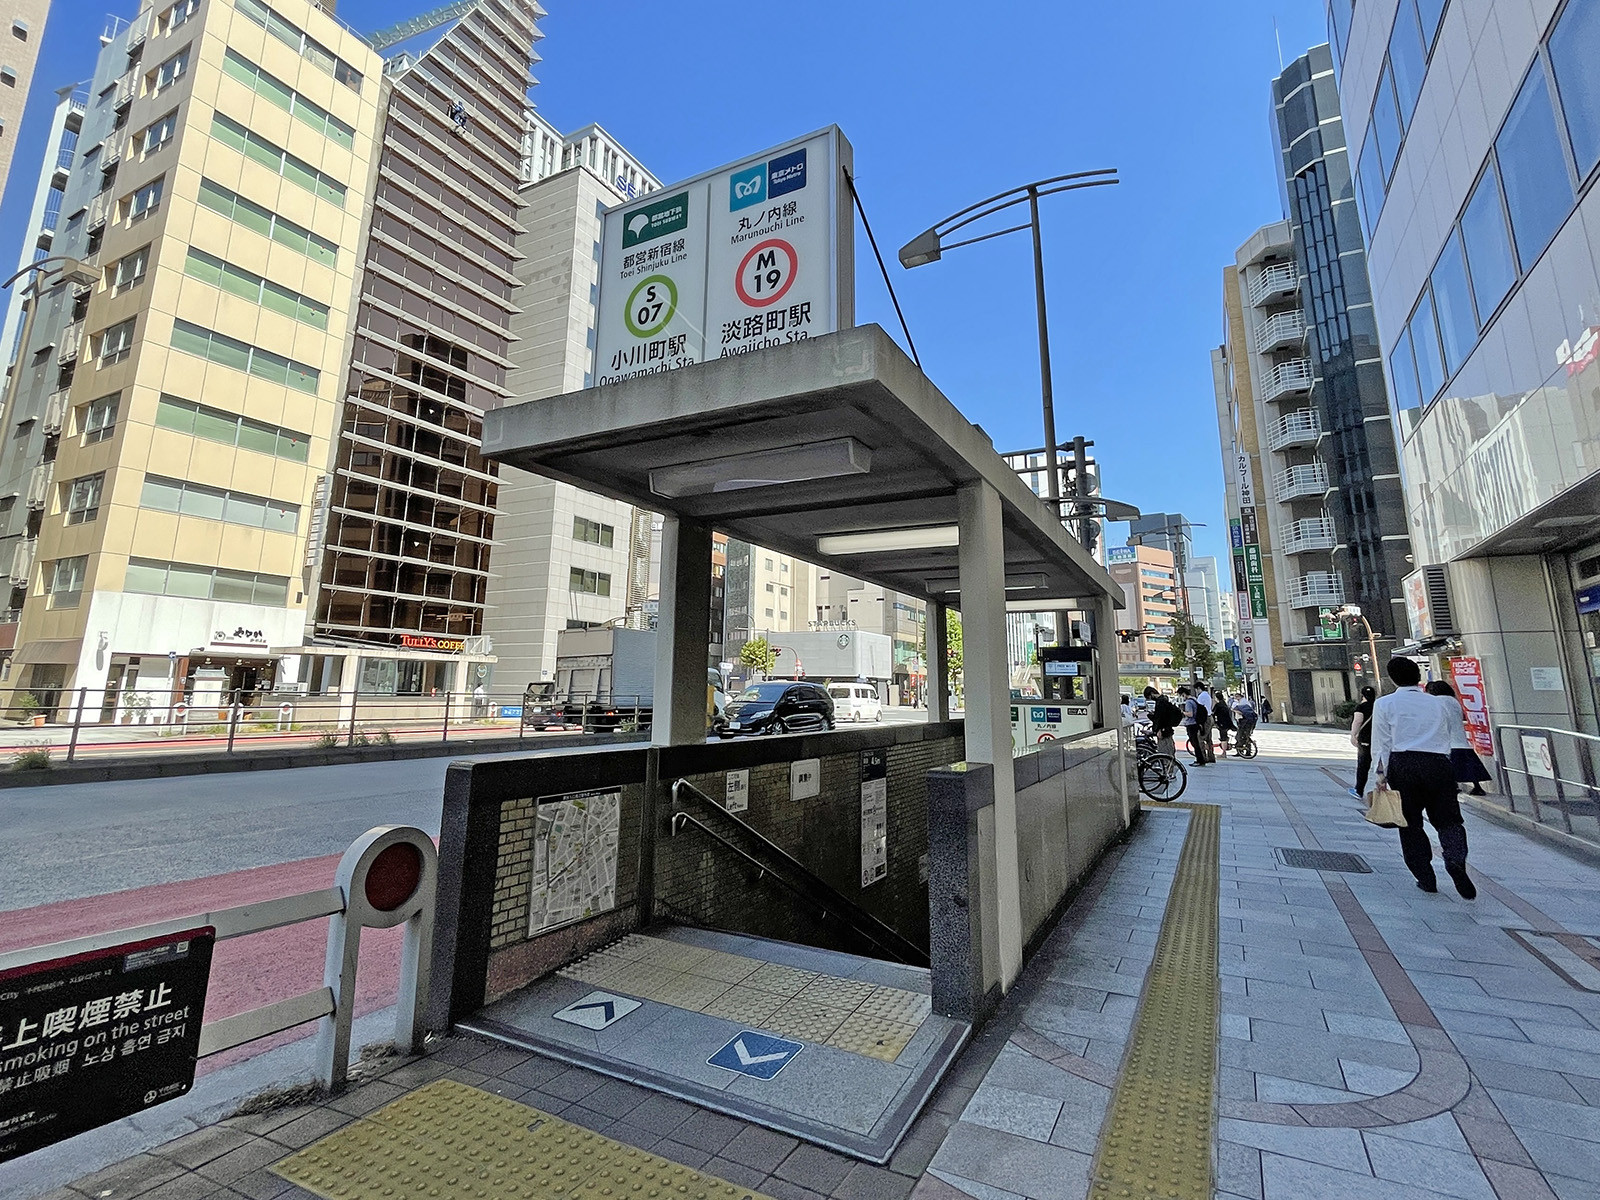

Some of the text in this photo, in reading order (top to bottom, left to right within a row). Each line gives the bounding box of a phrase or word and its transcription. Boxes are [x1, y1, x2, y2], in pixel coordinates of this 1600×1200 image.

[771, 163, 804, 179] 東京メトロ
[730, 215, 805, 245] Marunouchi Line
[738, 201, 797, 232] 丸ノ内線
[620, 253, 687, 279] Toei Shinjuku Line
[623, 238, 685, 269] 都営新宿線
[756, 249, 776, 271] M
[646, 285, 656, 303] S
[754, 269, 781, 293] 19
[637, 302, 664, 325] 07
[721, 301, 811, 344] 淡路町駅
[611, 333, 687, 371] 小川町駅
[807, 619, 856, 627] STARBUCKS
[0, 982, 172, 1051] 上喫煙禁止
[83, 1031, 107, 1047] on
[111, 1019, 139, 1040] the
[144, 1005, 190, 1030] street
[82, 1046, 116, 1068] 노상
[156, 1023, 186, 1044] 금지
